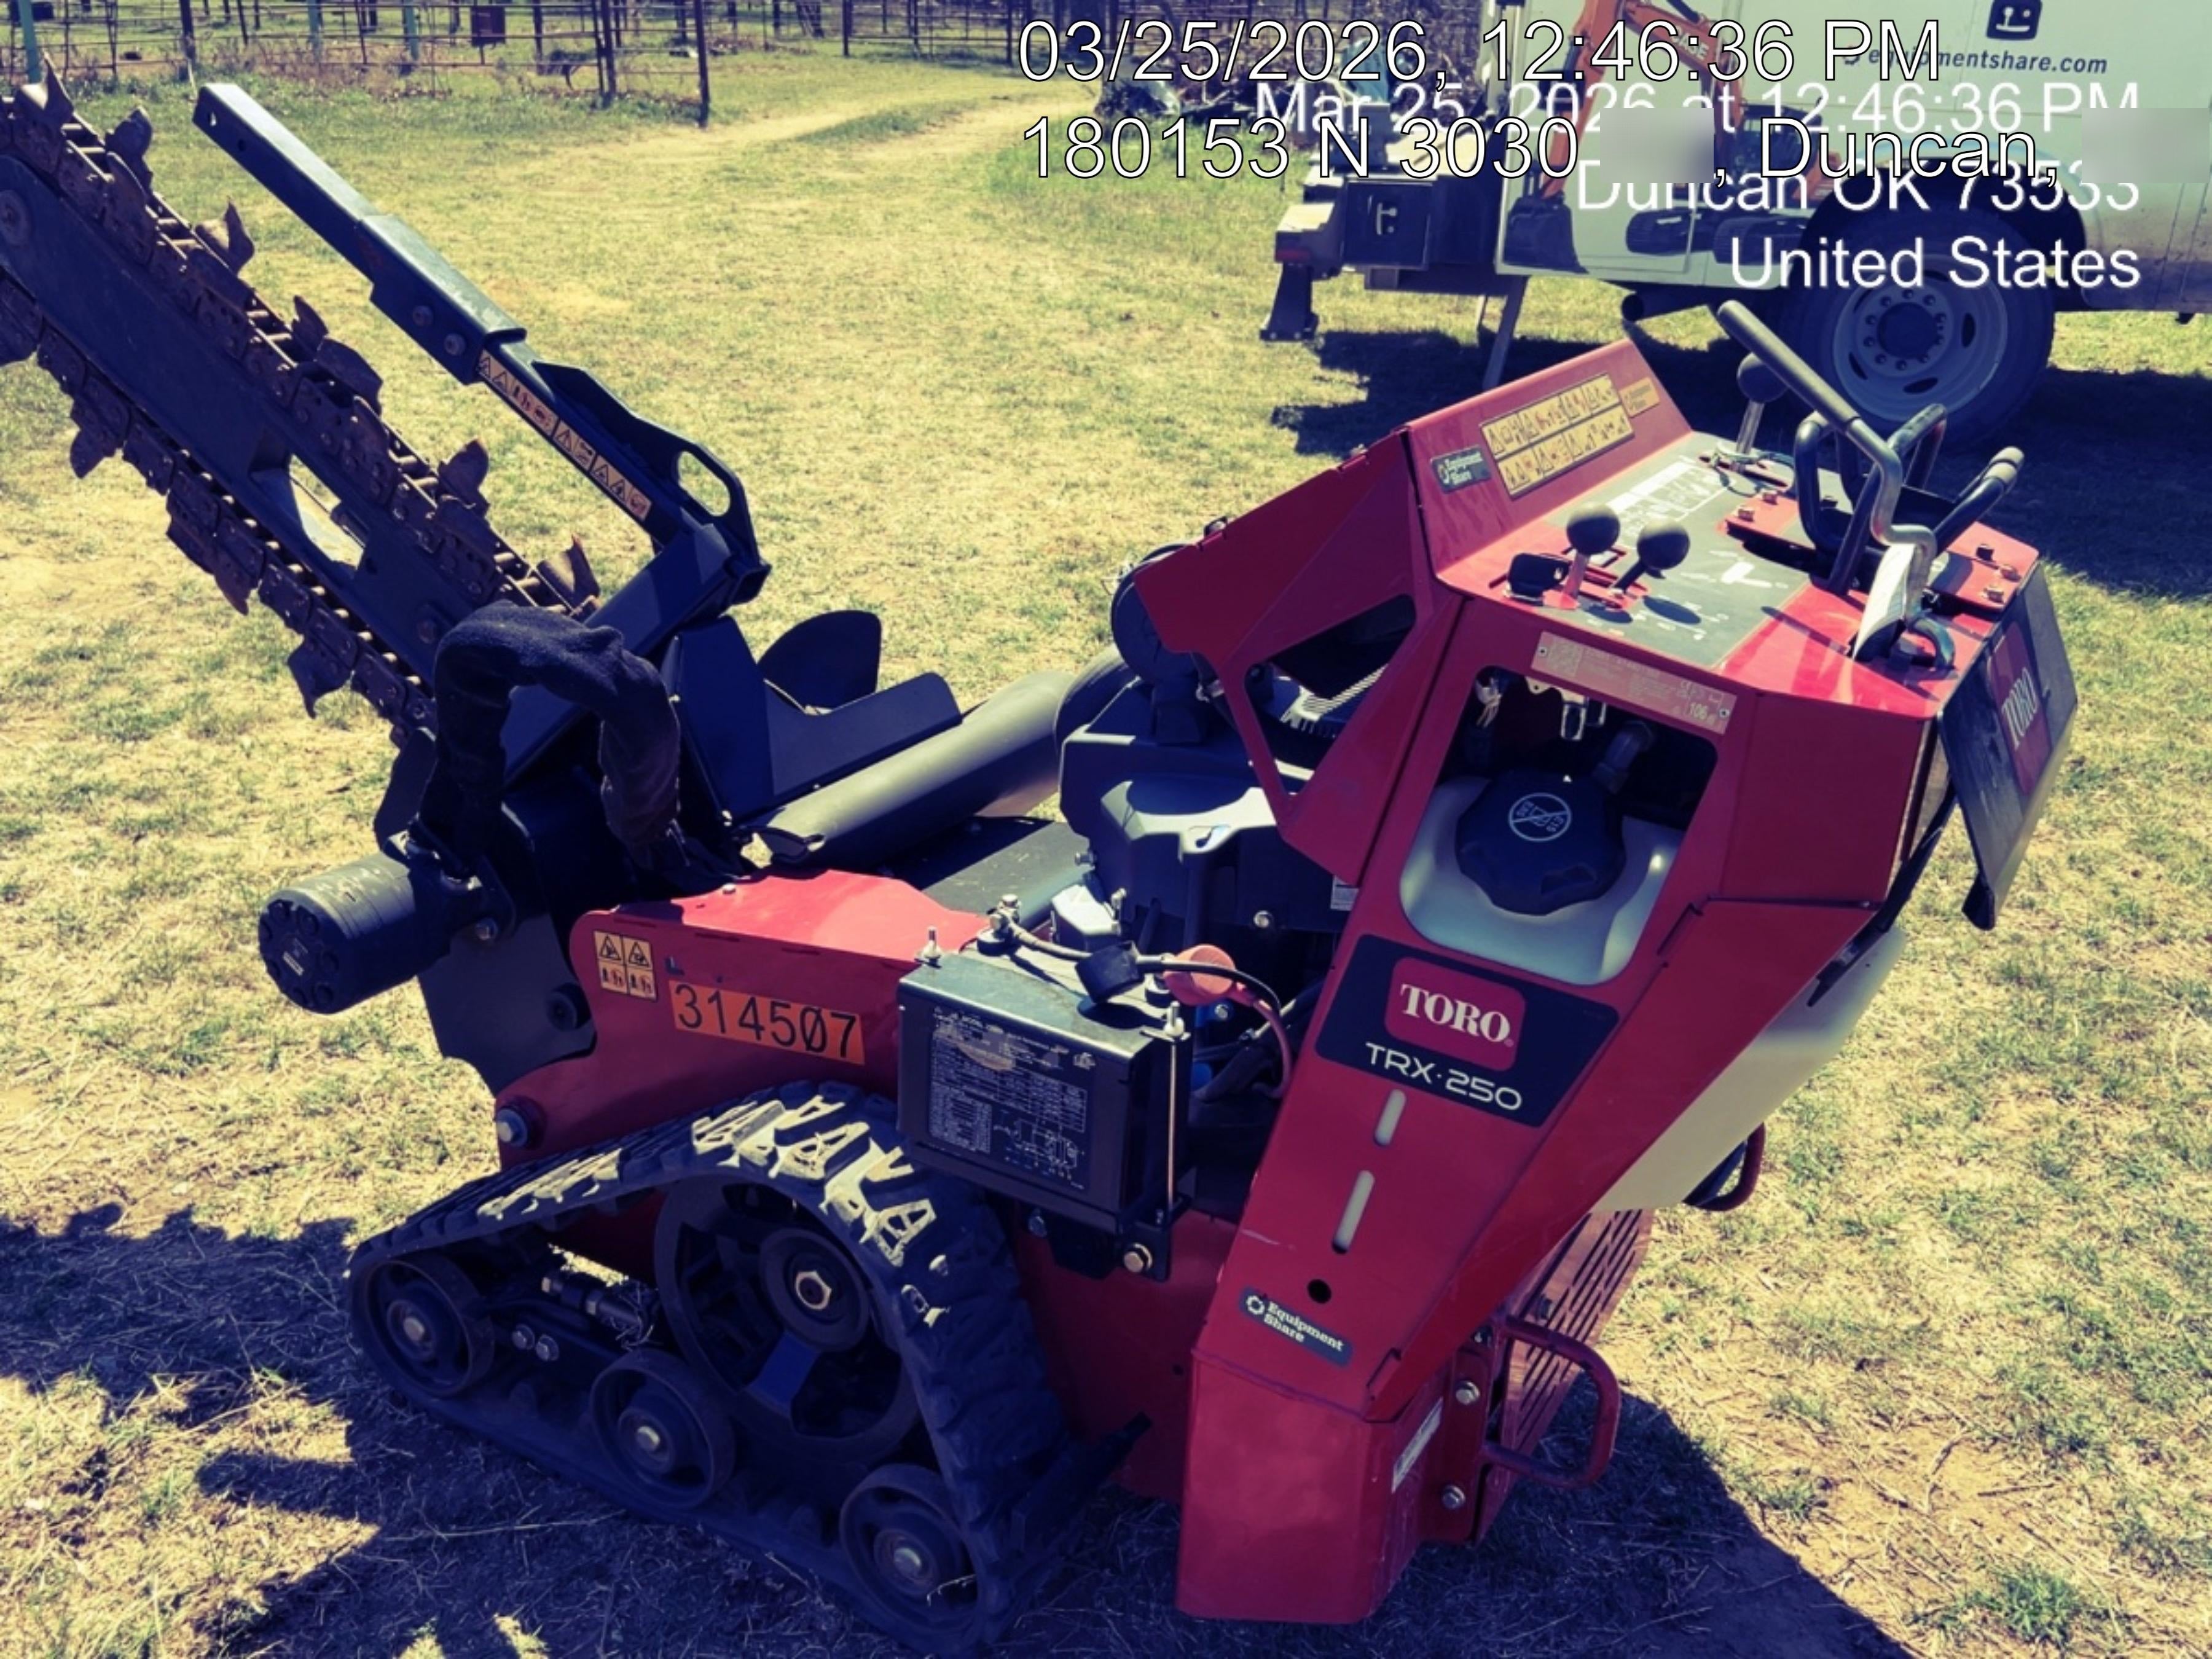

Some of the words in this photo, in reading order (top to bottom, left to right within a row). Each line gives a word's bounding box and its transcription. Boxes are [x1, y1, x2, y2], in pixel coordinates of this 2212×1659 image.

[675, 984, 857, 1058] 314507
[1400, 984, 1514, 1047] TORO
[1264, 1313, 1304, 1343] Share
[1268, 1301, 1343, 1351] Equipment
